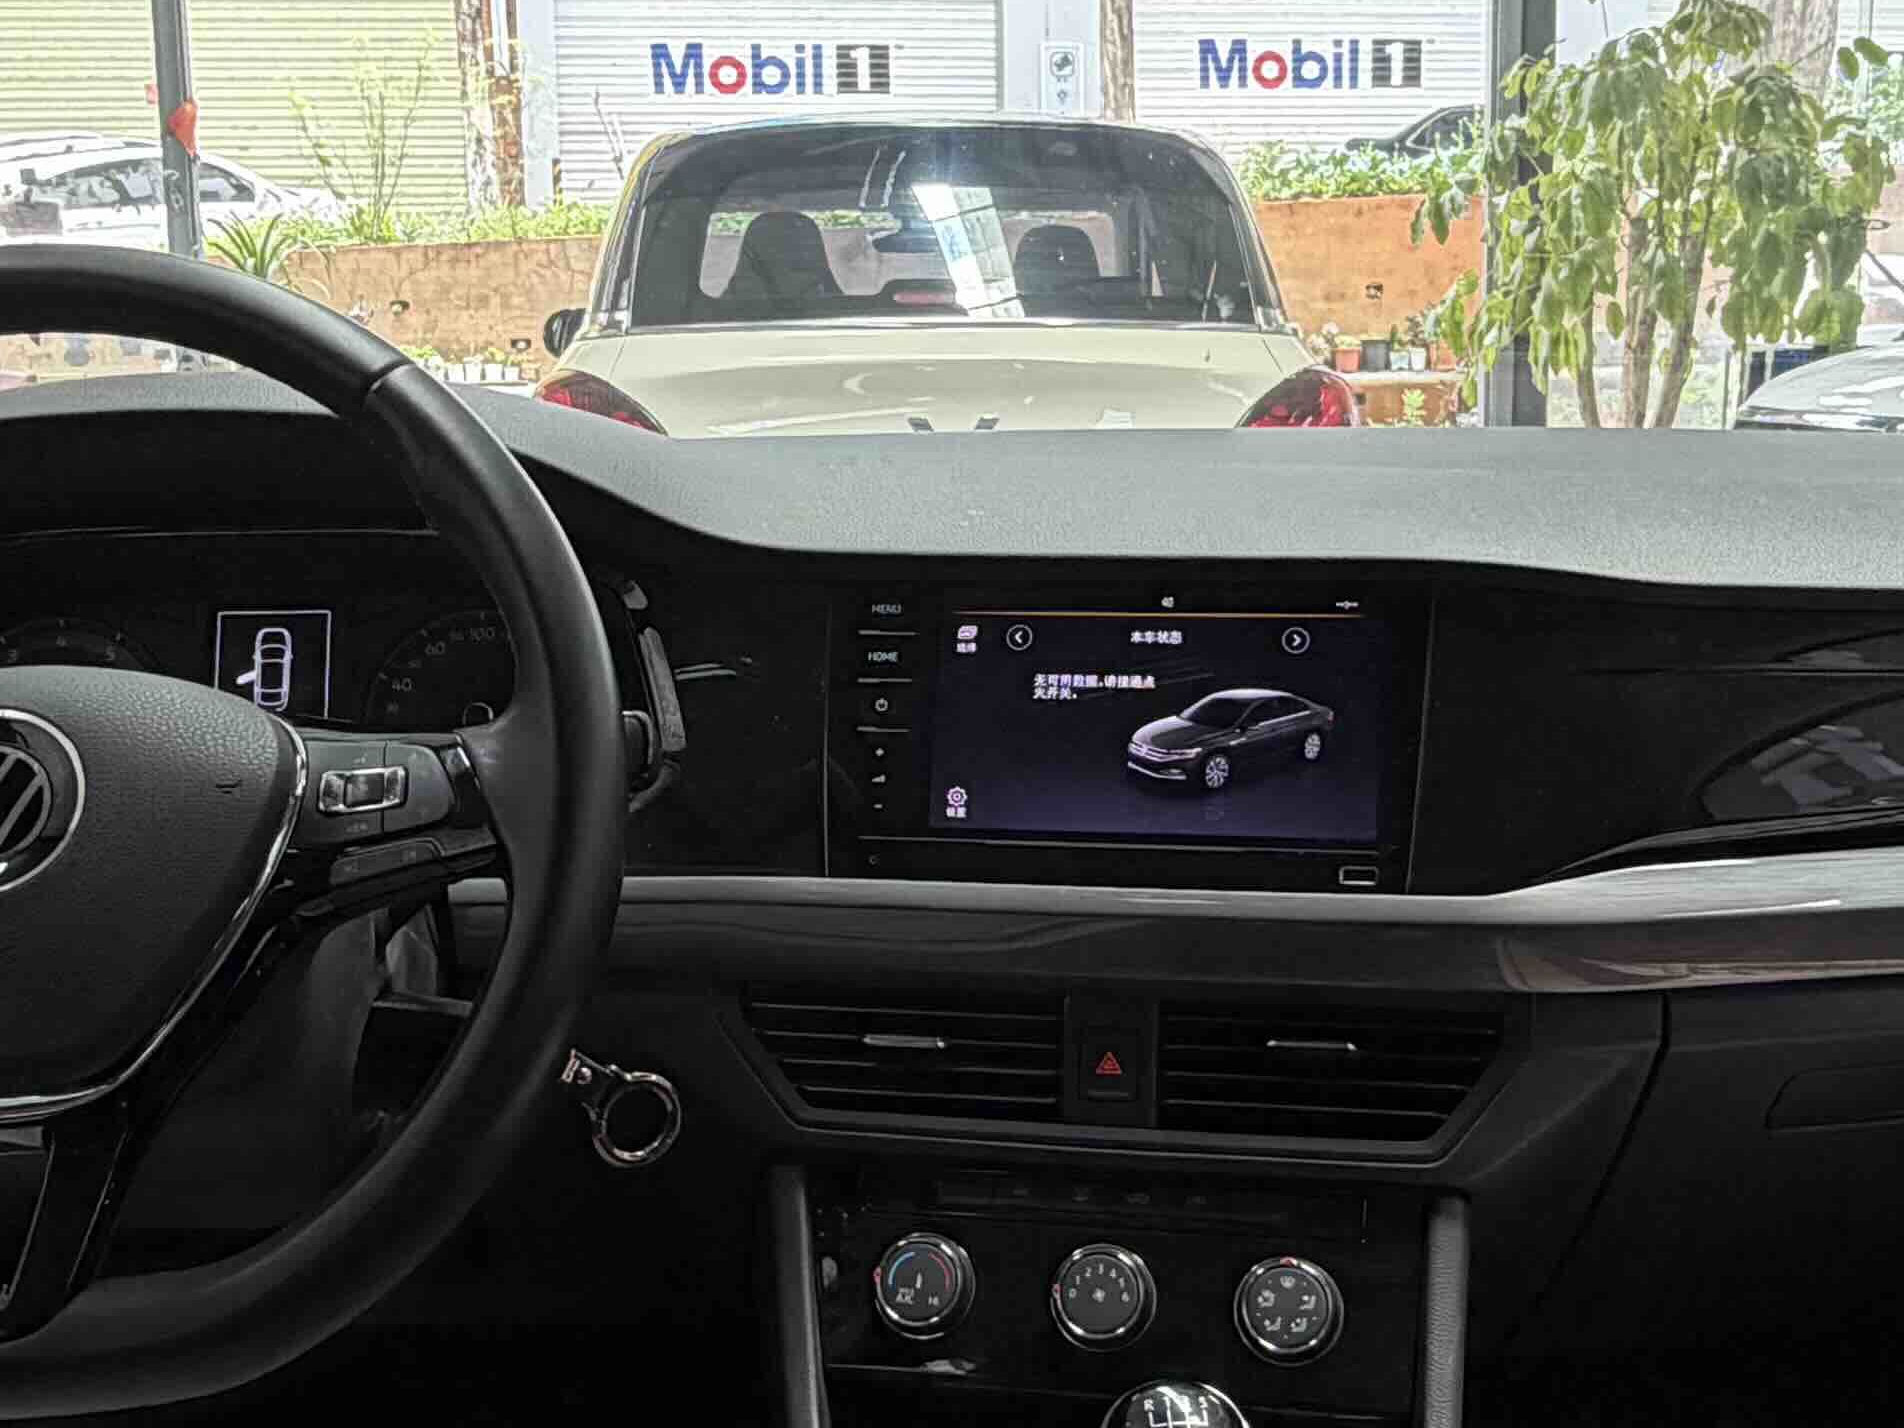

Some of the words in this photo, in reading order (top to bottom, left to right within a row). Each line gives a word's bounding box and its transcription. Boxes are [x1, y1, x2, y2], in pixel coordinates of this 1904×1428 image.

[649, 42, 824, 95] Mobil
[1197, 39, 1360, 90] Mobil
[867, 651, 899, 662] HOME
